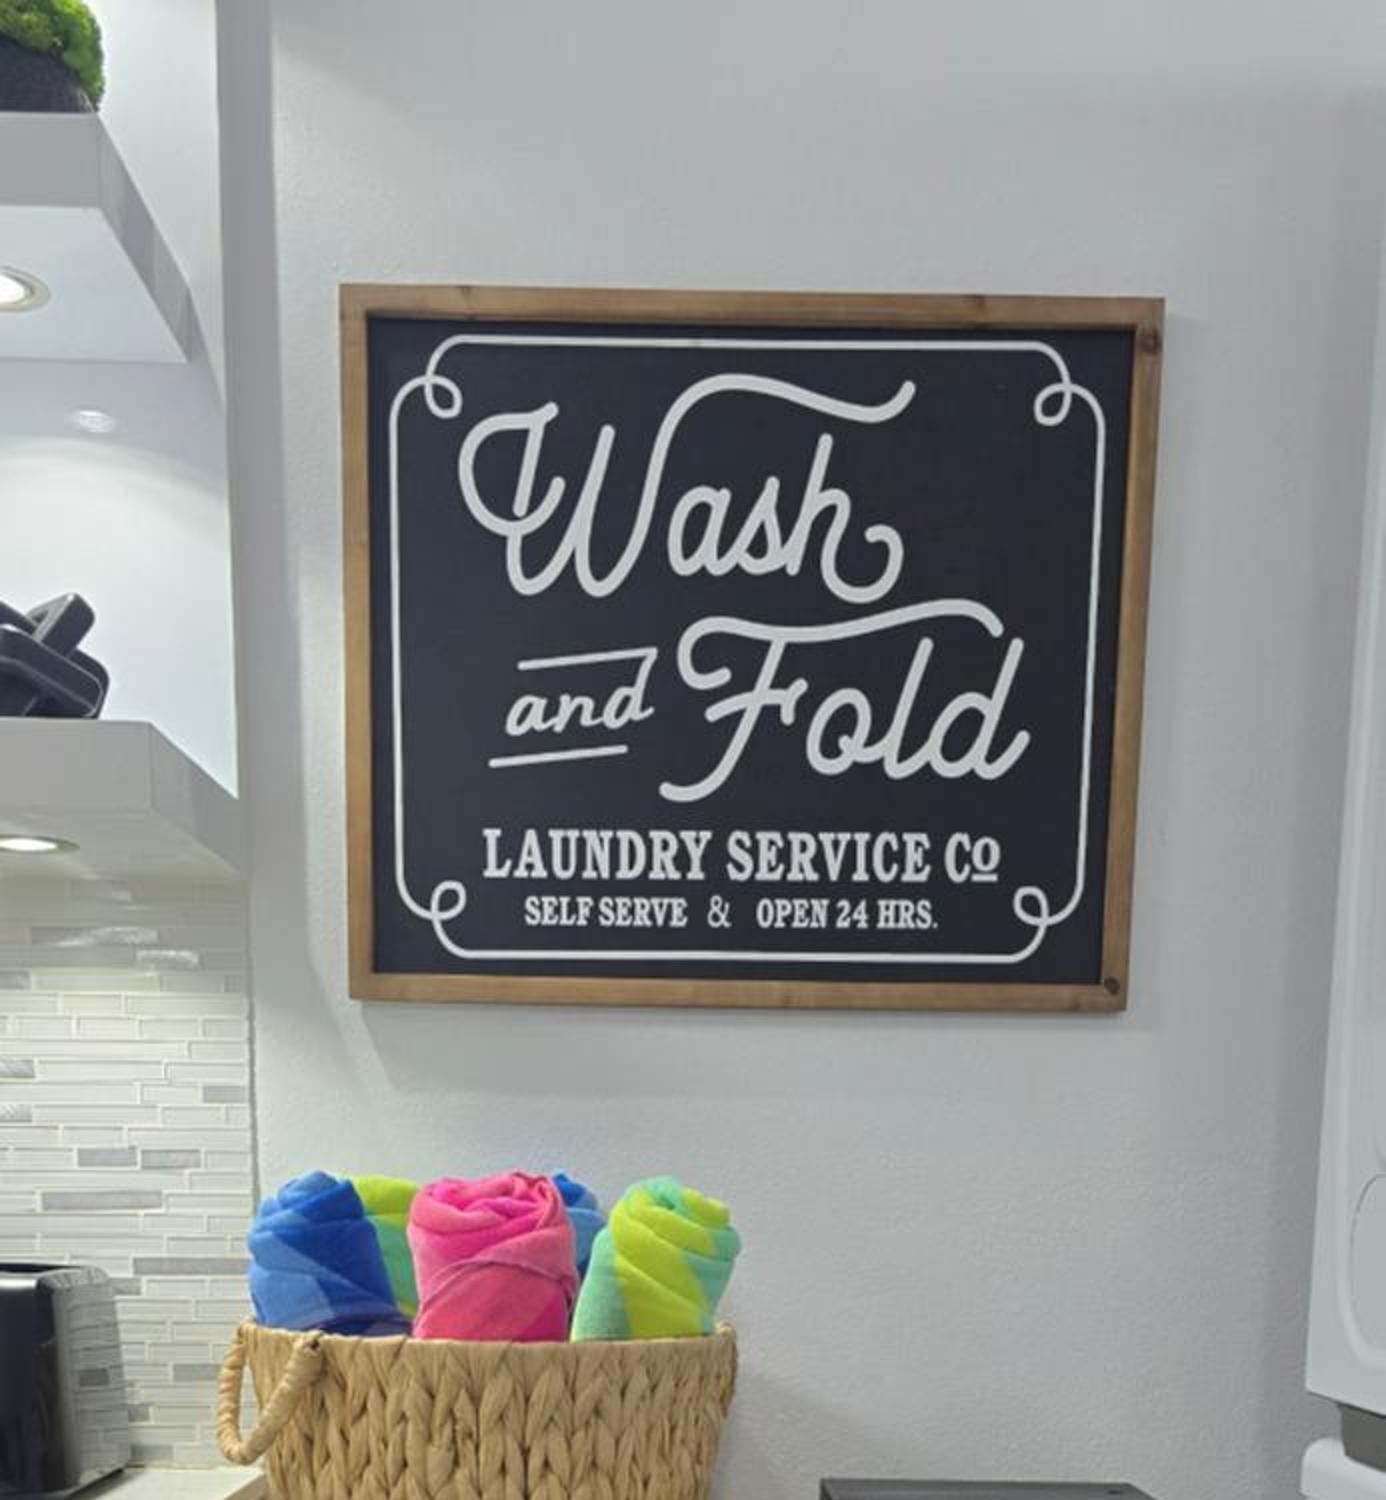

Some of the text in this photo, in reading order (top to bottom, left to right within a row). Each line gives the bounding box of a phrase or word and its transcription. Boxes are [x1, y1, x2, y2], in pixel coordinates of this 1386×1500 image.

[458, 373, 916, 604] Wash
[505, 598, 1031, 803] and Fold
[482, 827, 713, 881] LAUNDRY
[726, 829, 931, 883] SERVICE
[524, 894, 940, 930] SELF SERVE & OPEN 24 HRS.
